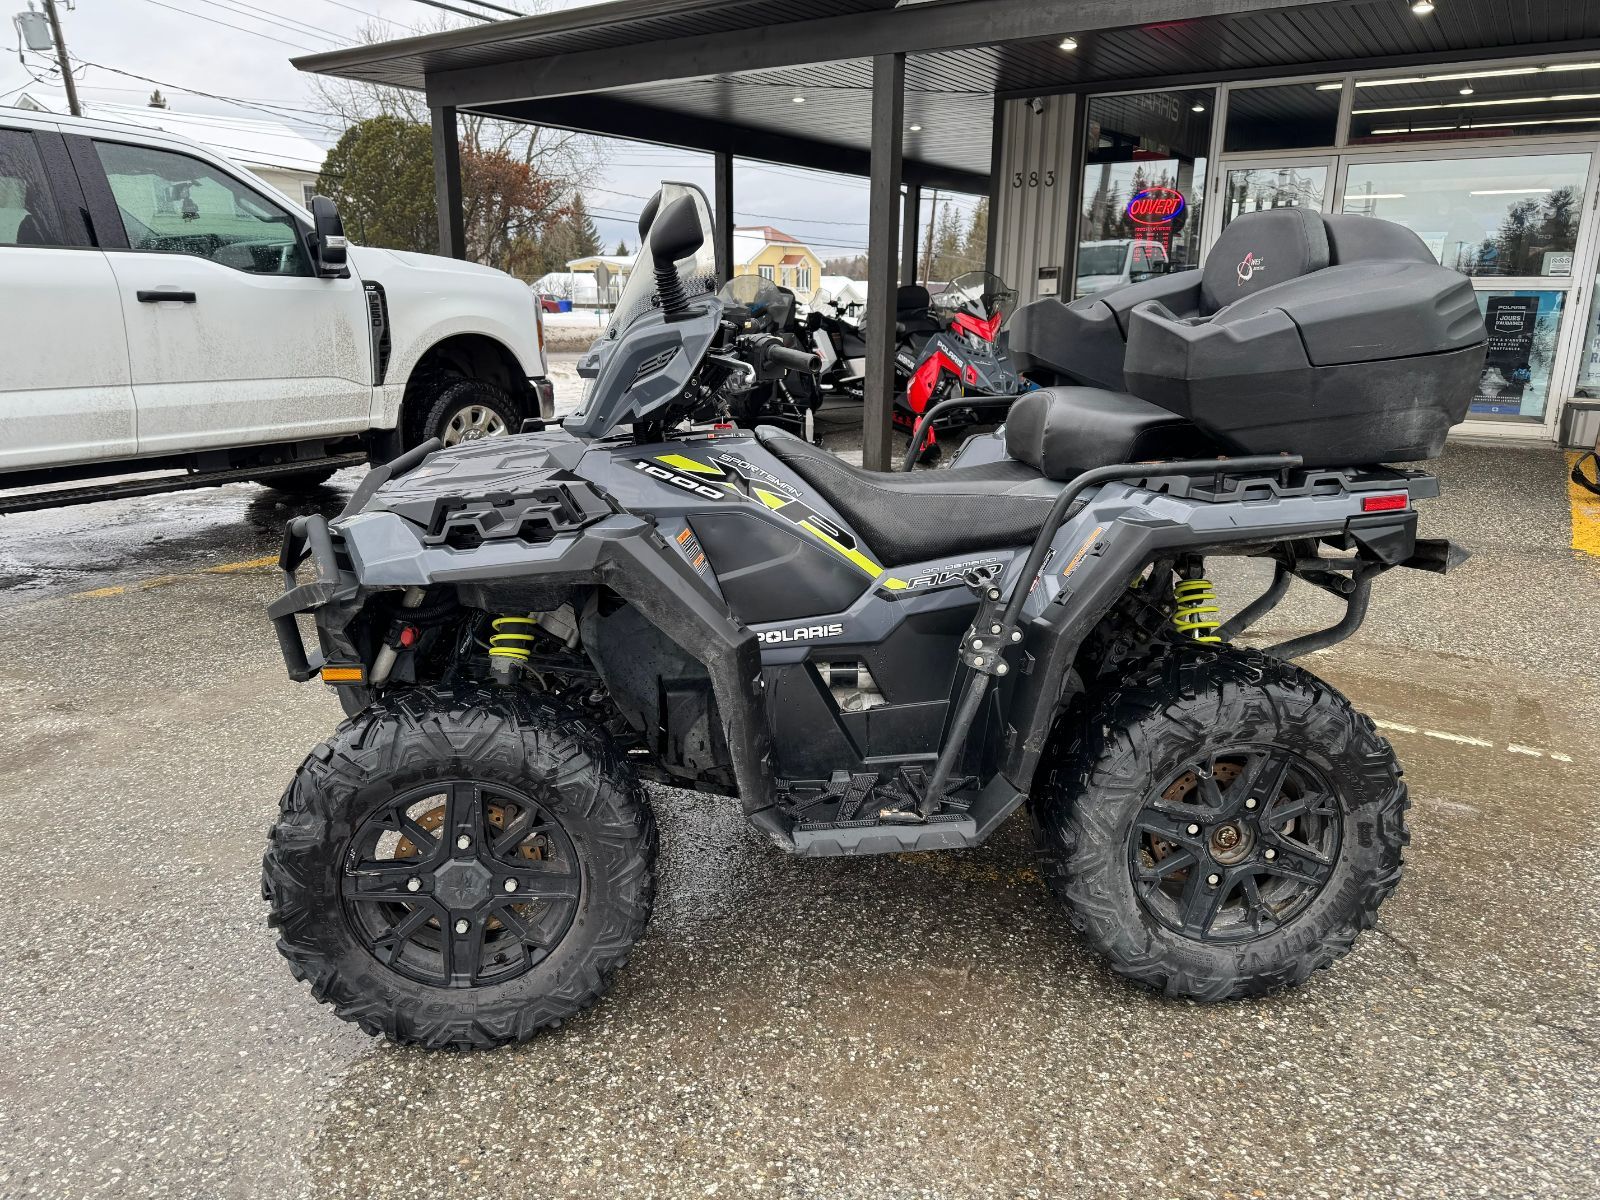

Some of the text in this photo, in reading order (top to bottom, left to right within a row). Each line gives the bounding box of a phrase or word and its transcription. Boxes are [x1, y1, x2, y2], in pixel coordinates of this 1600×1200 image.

[1013, 170, 1054, 188] 383
[1130, 198, 1180, 215] OUVERT
[937, 340, 964, 368] POLARIS
[634, 461, 725, 500] 1000
[718, 453, 803, 498] SPORTSMAN
[757, 623, 843, 644] POLARIS
